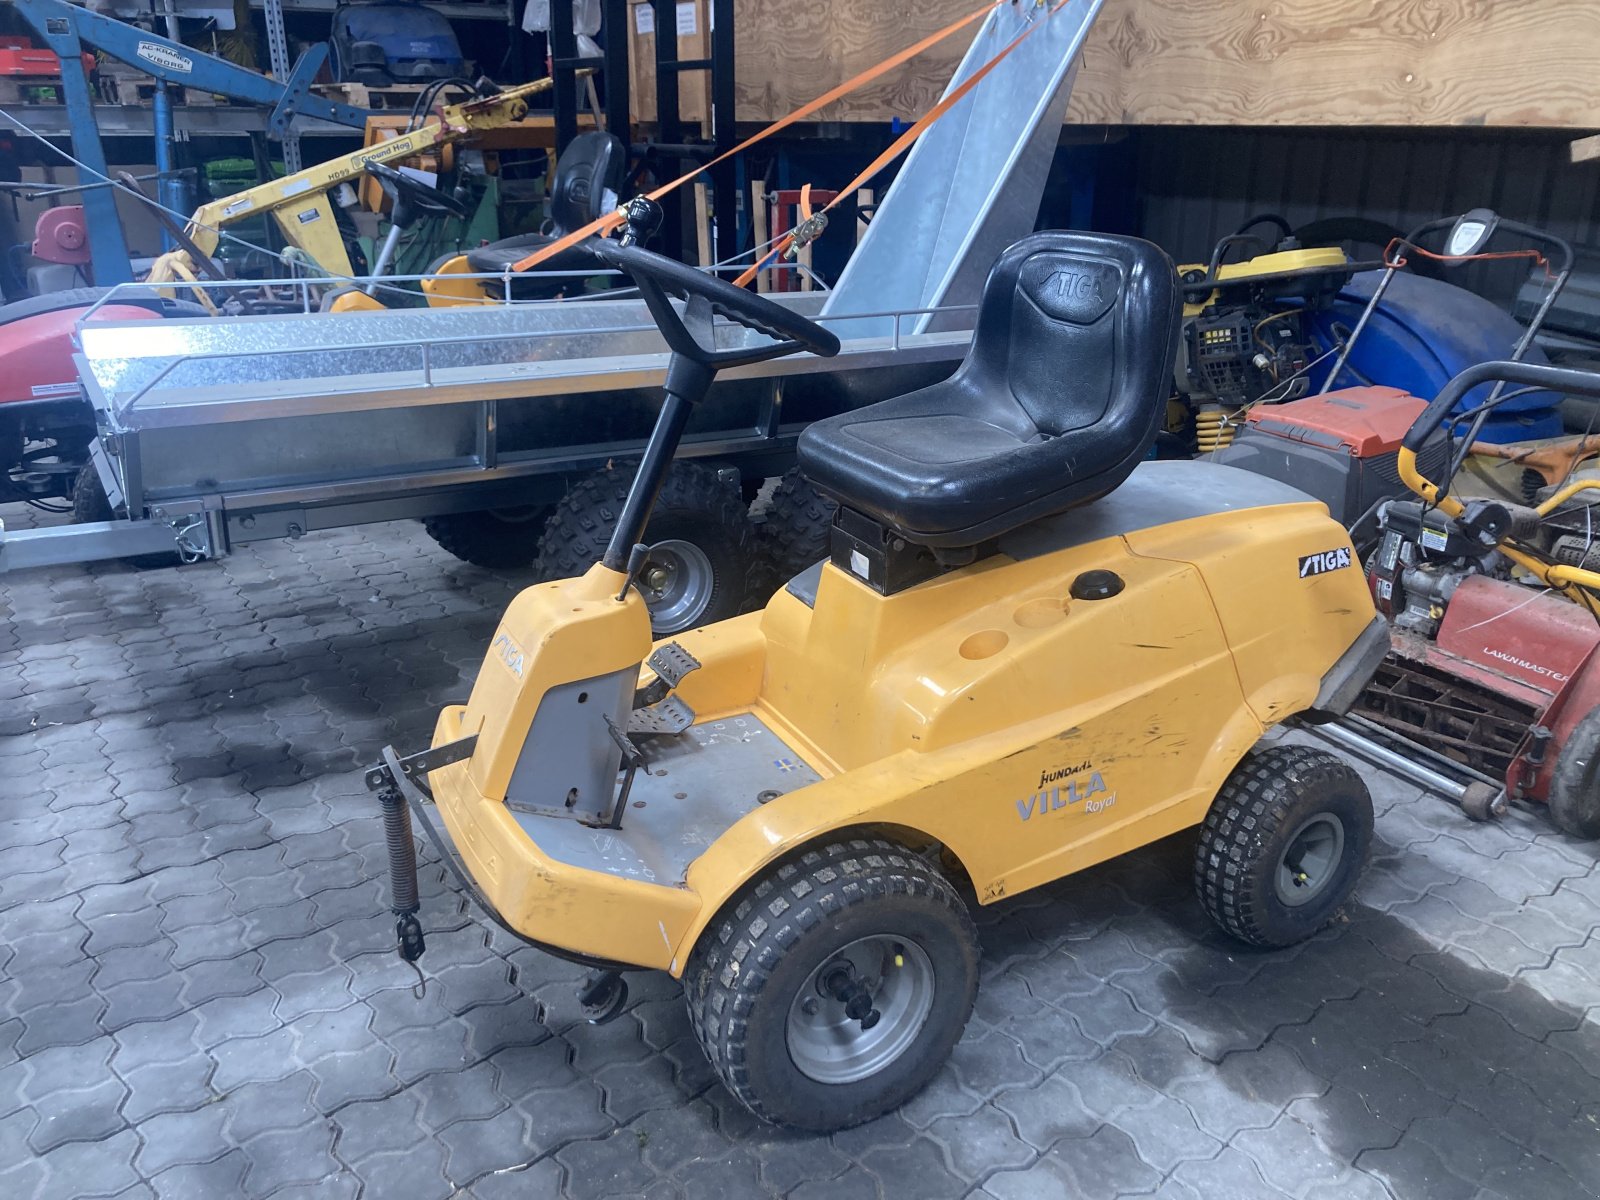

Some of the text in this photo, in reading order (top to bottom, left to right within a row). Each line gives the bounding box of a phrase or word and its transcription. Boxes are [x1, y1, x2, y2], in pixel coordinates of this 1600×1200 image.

[147, 53, 184, 69] VIBORG
[361, 142, 410, 163] Ground Hog
[1039, 270, 1104, 302] STIGA
[1300, 548, 1350, 578] STIGA
[494, 634, 524, 678] STIGA
[1016, 769, 1108, 821] VILLA
[1085, 791, 1117, 814] Royal
